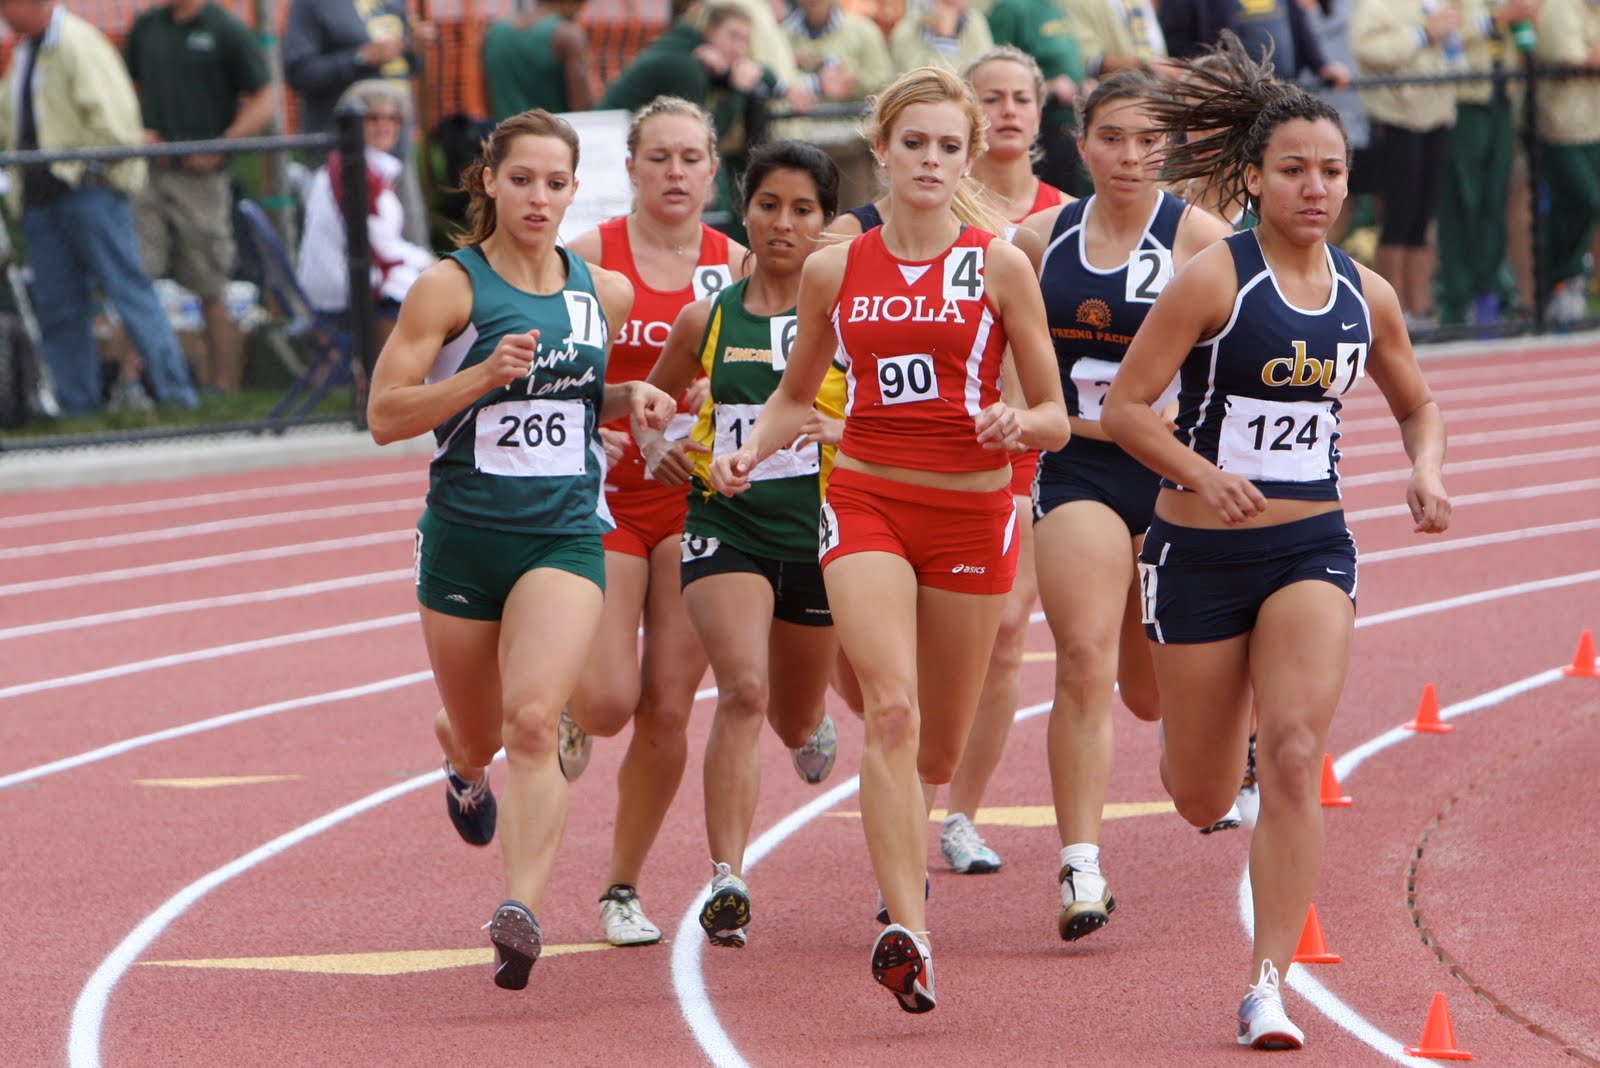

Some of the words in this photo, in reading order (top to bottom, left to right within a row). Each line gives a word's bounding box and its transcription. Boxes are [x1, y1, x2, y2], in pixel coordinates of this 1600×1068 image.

[951, 251, 981, 297] 4
[1135, 253, 1161, 299] 2
[573, 295, 592, 342] 7
[848, 296, 966, 324] BIOLA
[526, 332, 579, 377] int
[1340, 347, 1360, 396] 1
[879, 358, 933, 399] 90
[496, 412, 567, 448] 266
[1247, 414, 1320, 451] 124
